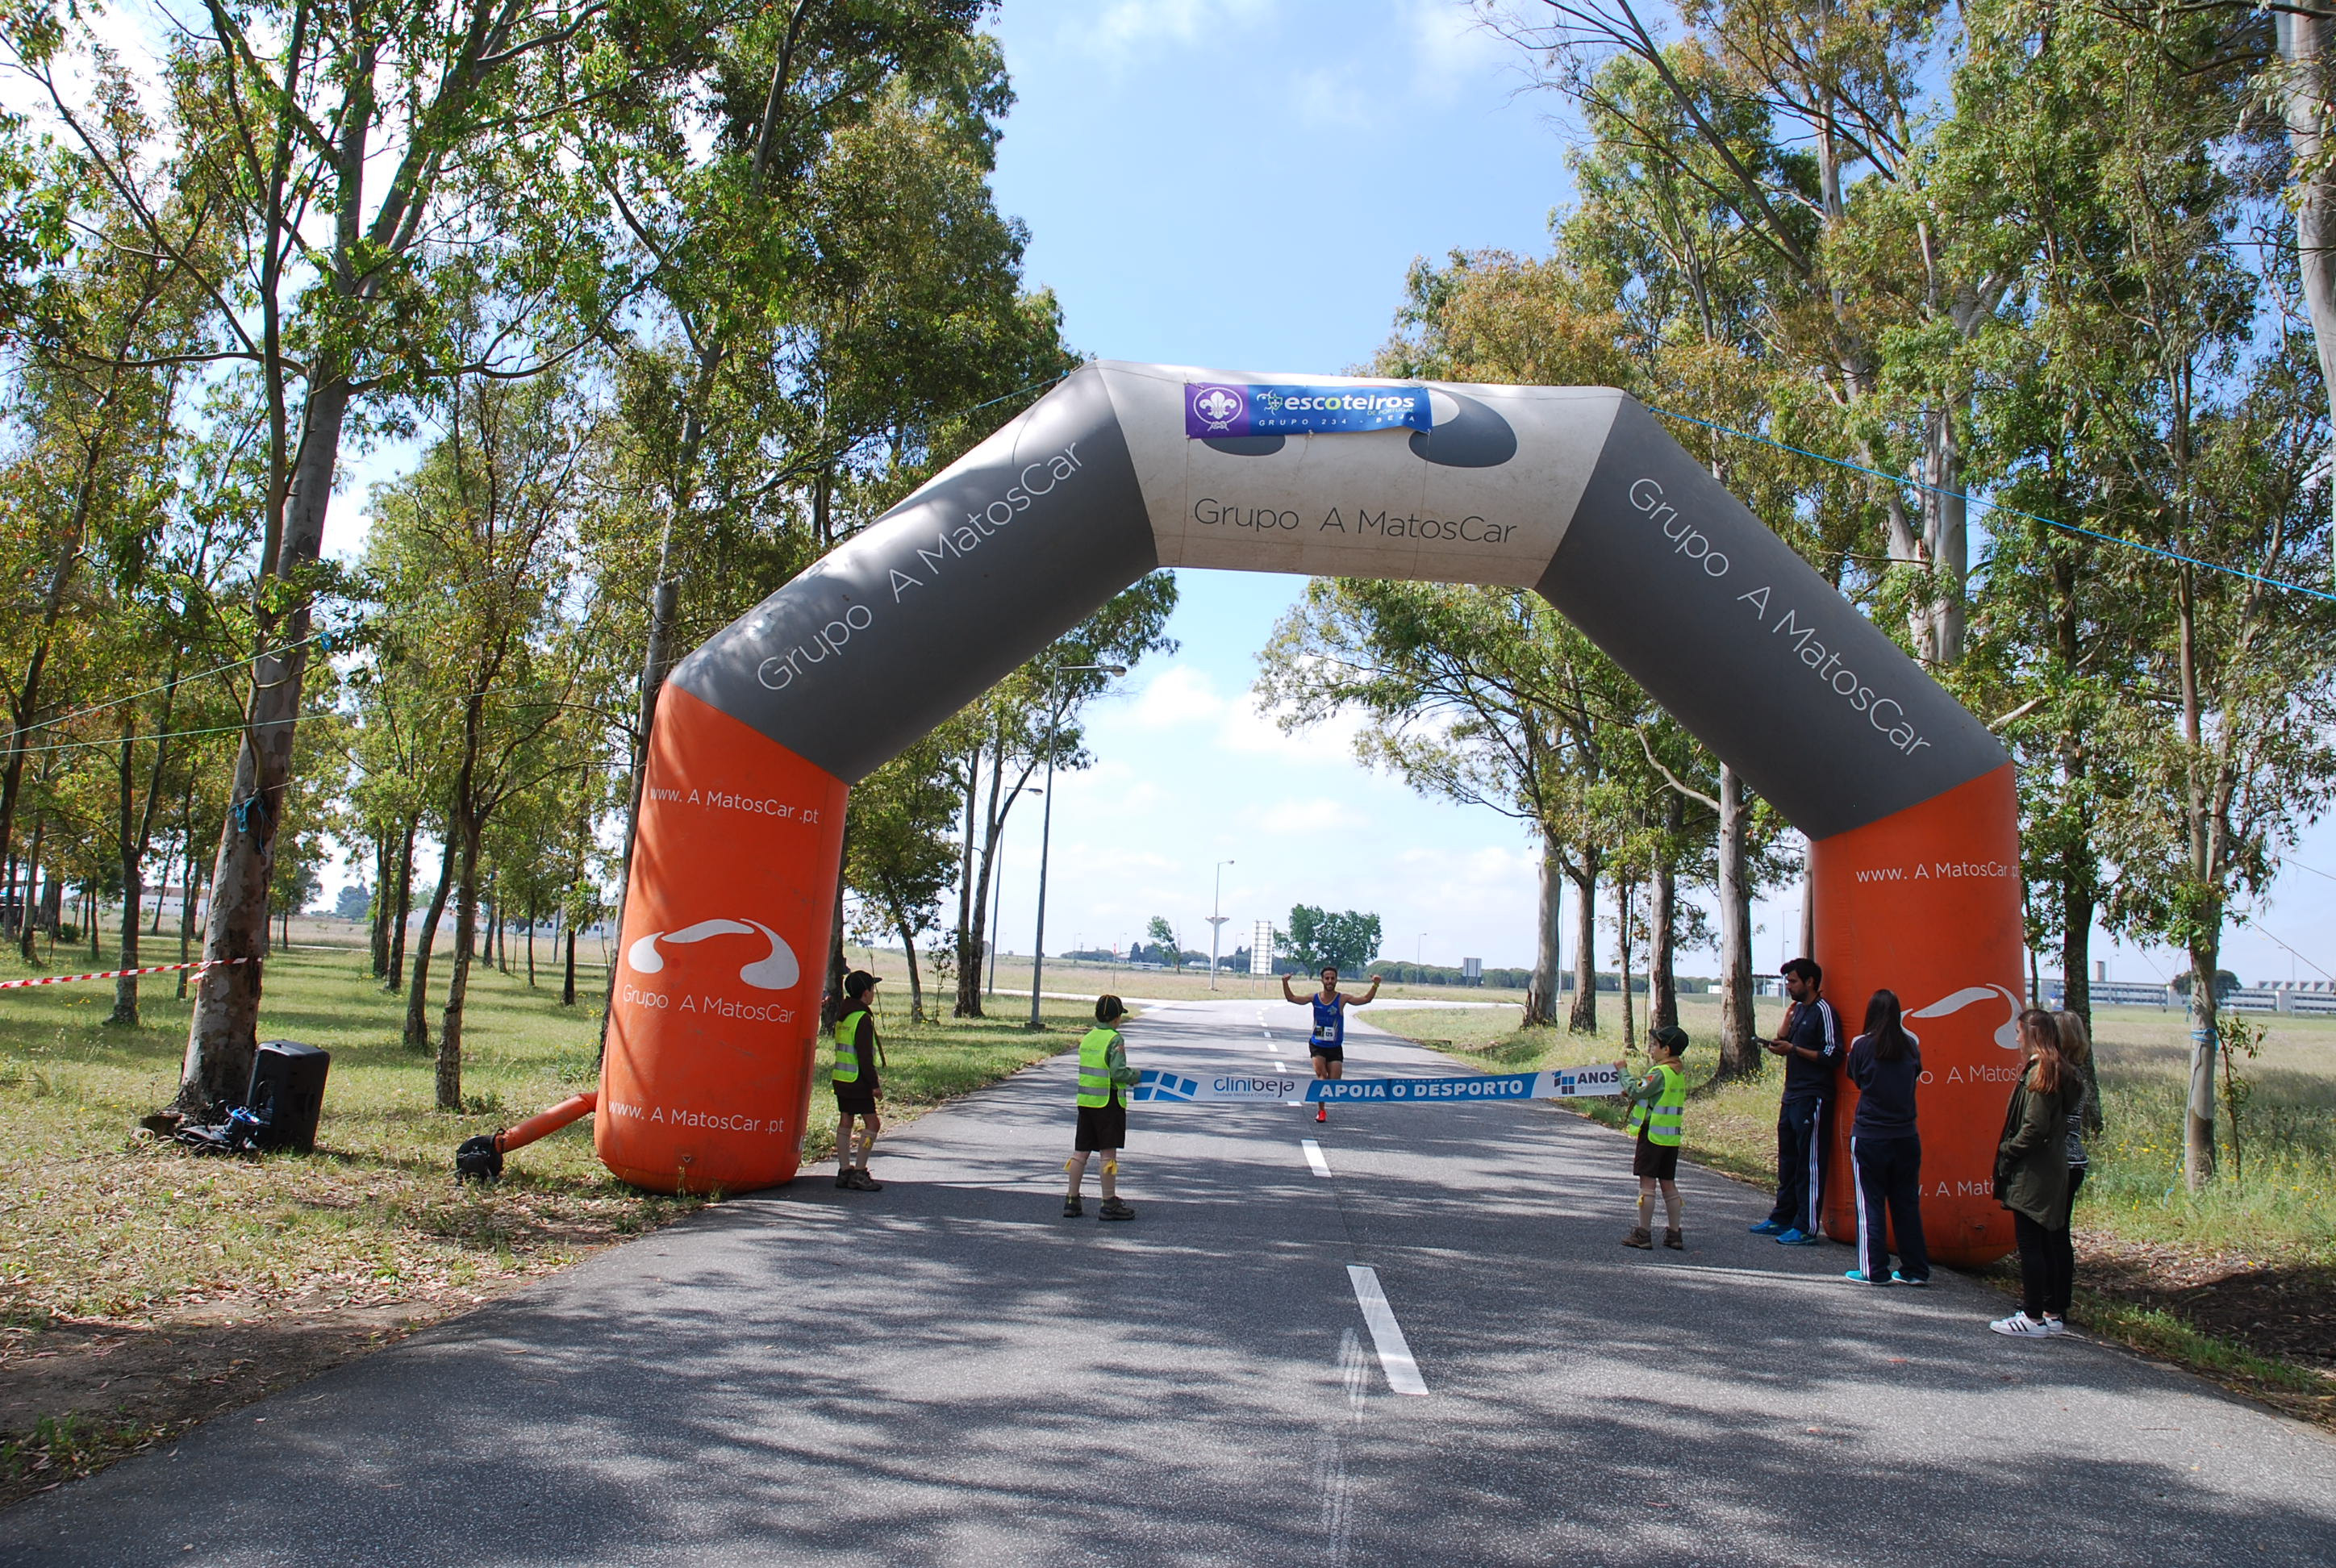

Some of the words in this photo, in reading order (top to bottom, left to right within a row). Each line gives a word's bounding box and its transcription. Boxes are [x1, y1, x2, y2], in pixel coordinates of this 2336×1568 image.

[1284, 394, 1416, 411] escoteiros
[1375, 414, 1415, 423] BEJA
[1194, 498, 1299, 532] Grupo
[1320, 507, 1345, 533] A
[1358, 509, 1517, 544] MatosCar
[757, 605, 873, 690] Grupo
[888, 568, 924, 603] A
[916, 442, 1082, 575] MatosCar
[1629, 478, 1729, 577] Grupo
[1737, 586, 1771, 620] A
[1772, 609, 1931, 756] MatosCar
[650, 787, 682, 803] www.
[687, 789, 700, 804] A
[706, 790, 795, 818] MatosCar
[799, 808, 820, 824] .pt
[1856, 868, 1908, 882] www.
[1914, 863, 1929, 879] A
[1936, 861, 2008, 878] MatosCar
[623, 984, 669, 1008] Grupo
[679, 995, 696, 1013] A
[703, 996, 795, 1024] MatosCar
[1577, 1071, 1619, 1084] ANOS
[1946, 1066, 1964, 1084] A
[1213, 1078, 1295, 1098] clinibeja
[1319, 1084, 1386, 1097] APOIA
[1392, 1085, 1407, 1098] O
[1413, 1079, 1523, 1097] DESPORTO
[608, 1100, 644, 1120] www.
[650, 1107, 664, 1123] A
[671, 1109, 761, 1131] MatosCar
[765, 1118, 784, 1134] .pt
[1936, 1181, 1950, 1197] A
